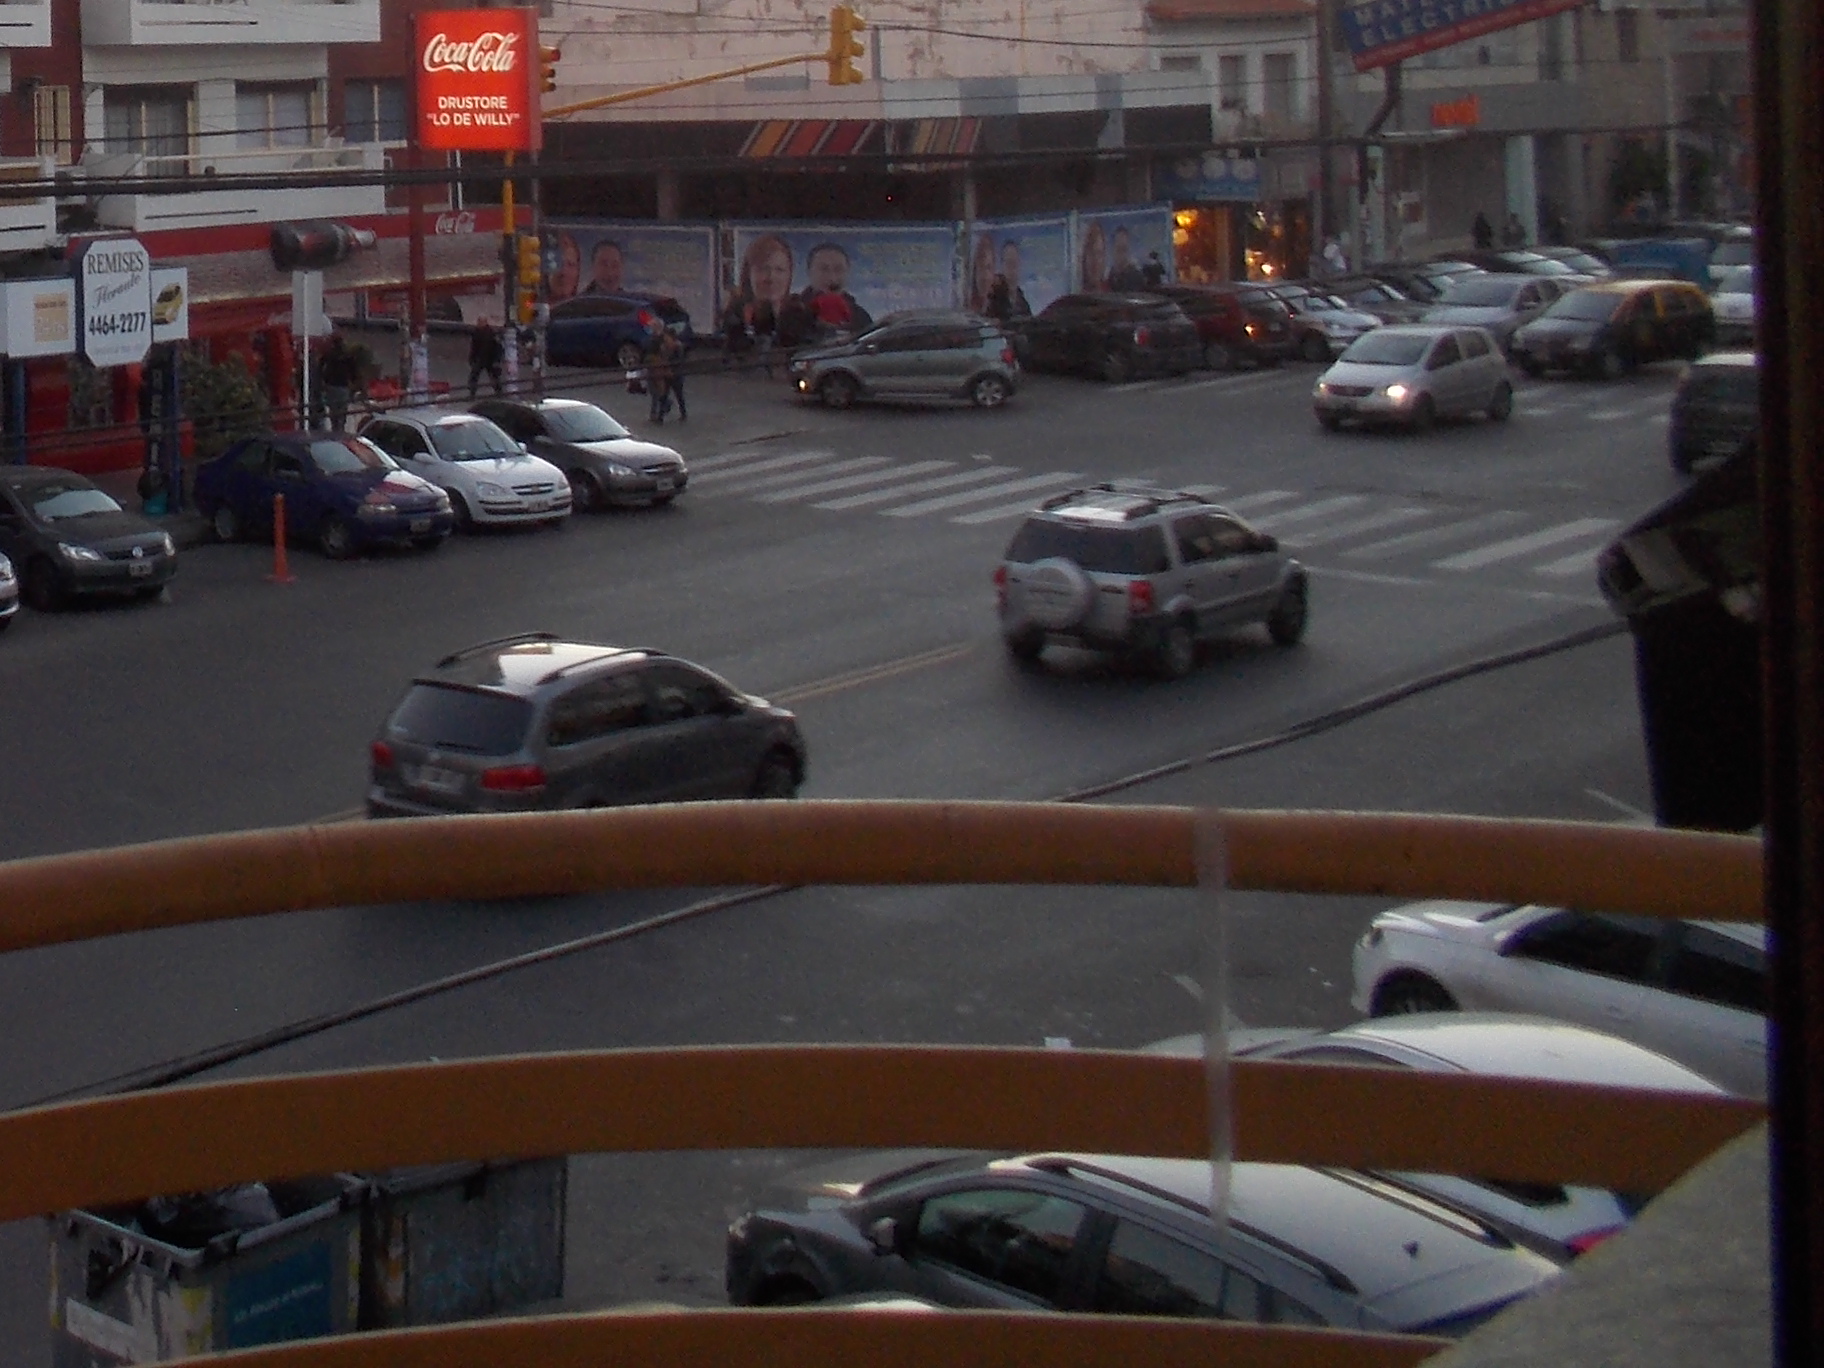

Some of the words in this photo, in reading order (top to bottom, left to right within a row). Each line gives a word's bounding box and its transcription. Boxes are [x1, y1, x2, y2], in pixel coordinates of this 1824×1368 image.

[423, 32, 519, 72] Coca-Cola
[438, 96, 508, 109] DRUSTORE
[453, 113, 472, 125] DE
[87, 250, 145, 275] REMISES
[89, 312, 147, 336] 4464-2277
